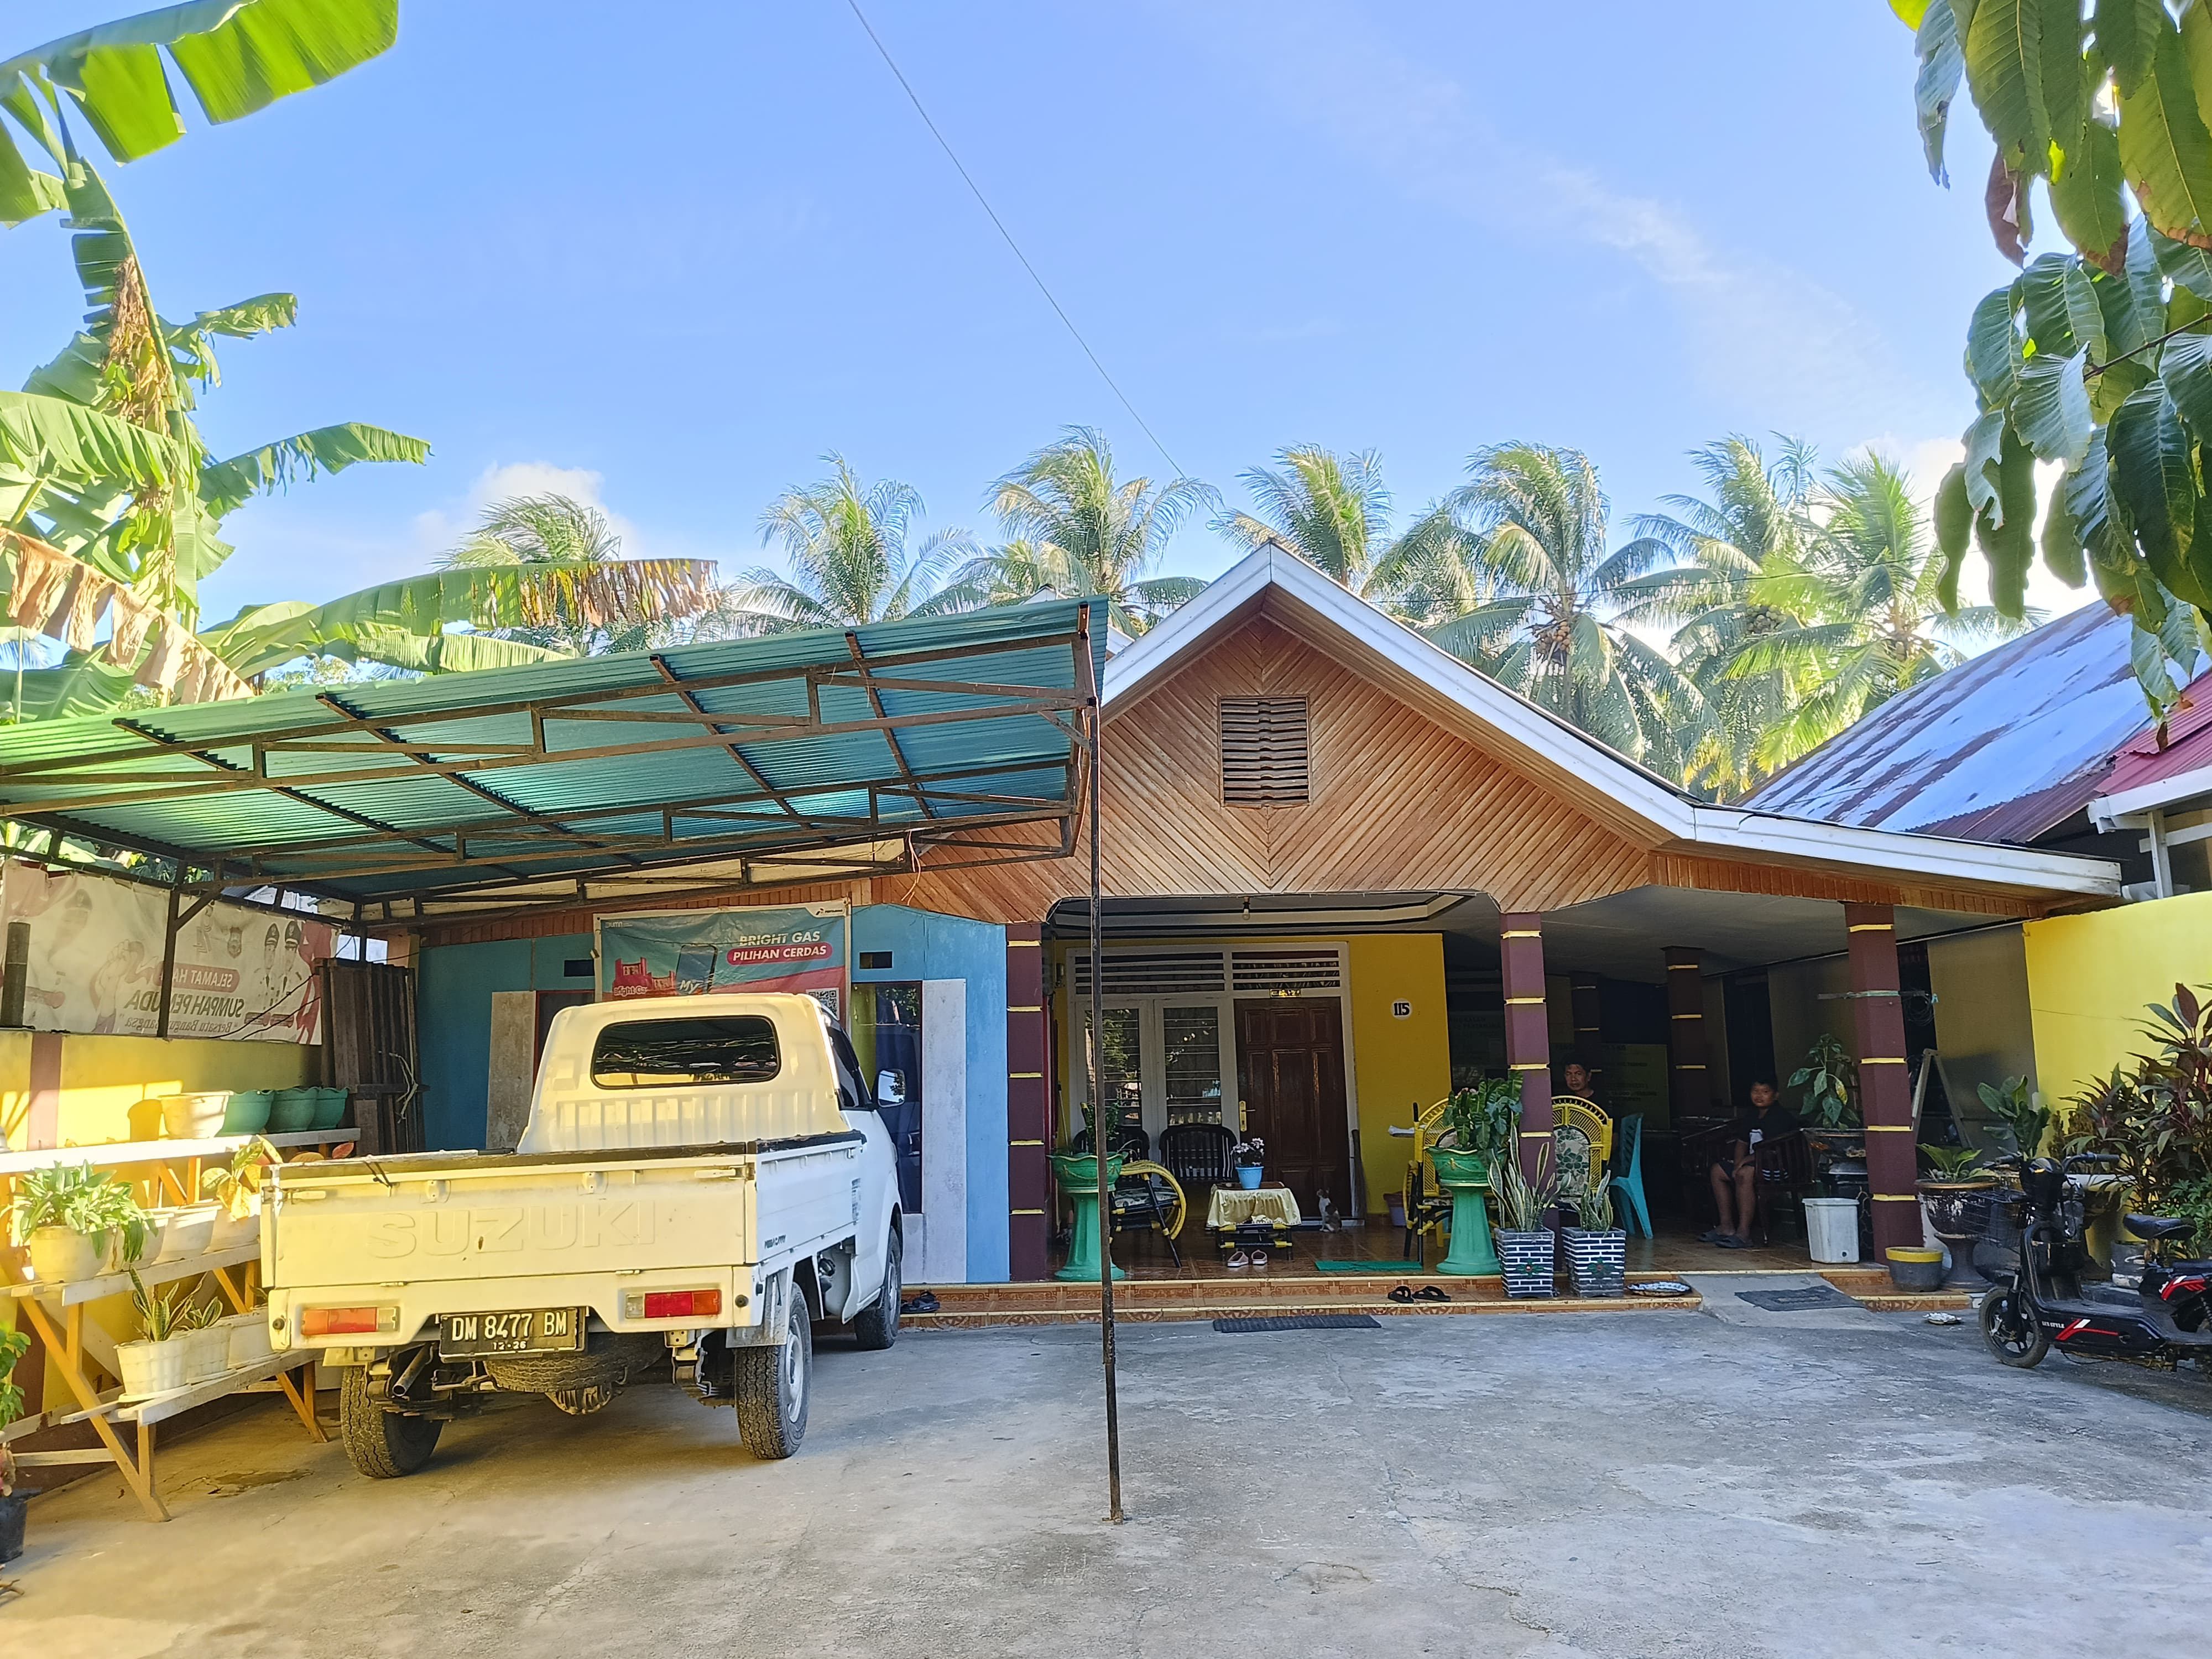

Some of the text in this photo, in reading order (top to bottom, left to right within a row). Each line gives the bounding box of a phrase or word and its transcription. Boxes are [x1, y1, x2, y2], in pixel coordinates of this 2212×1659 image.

[739, 931, 821, 947] BRIGHT GAS
[733, 946, 827, 961] PILIHAN CERDAS
[679, 979, 700, 994] My
[1394, 1003, 1410, 1015] 115
[366, 1200, 655, 1259] SUZUKI
[452, 1311, 567, 1342] DM 8477 BM
